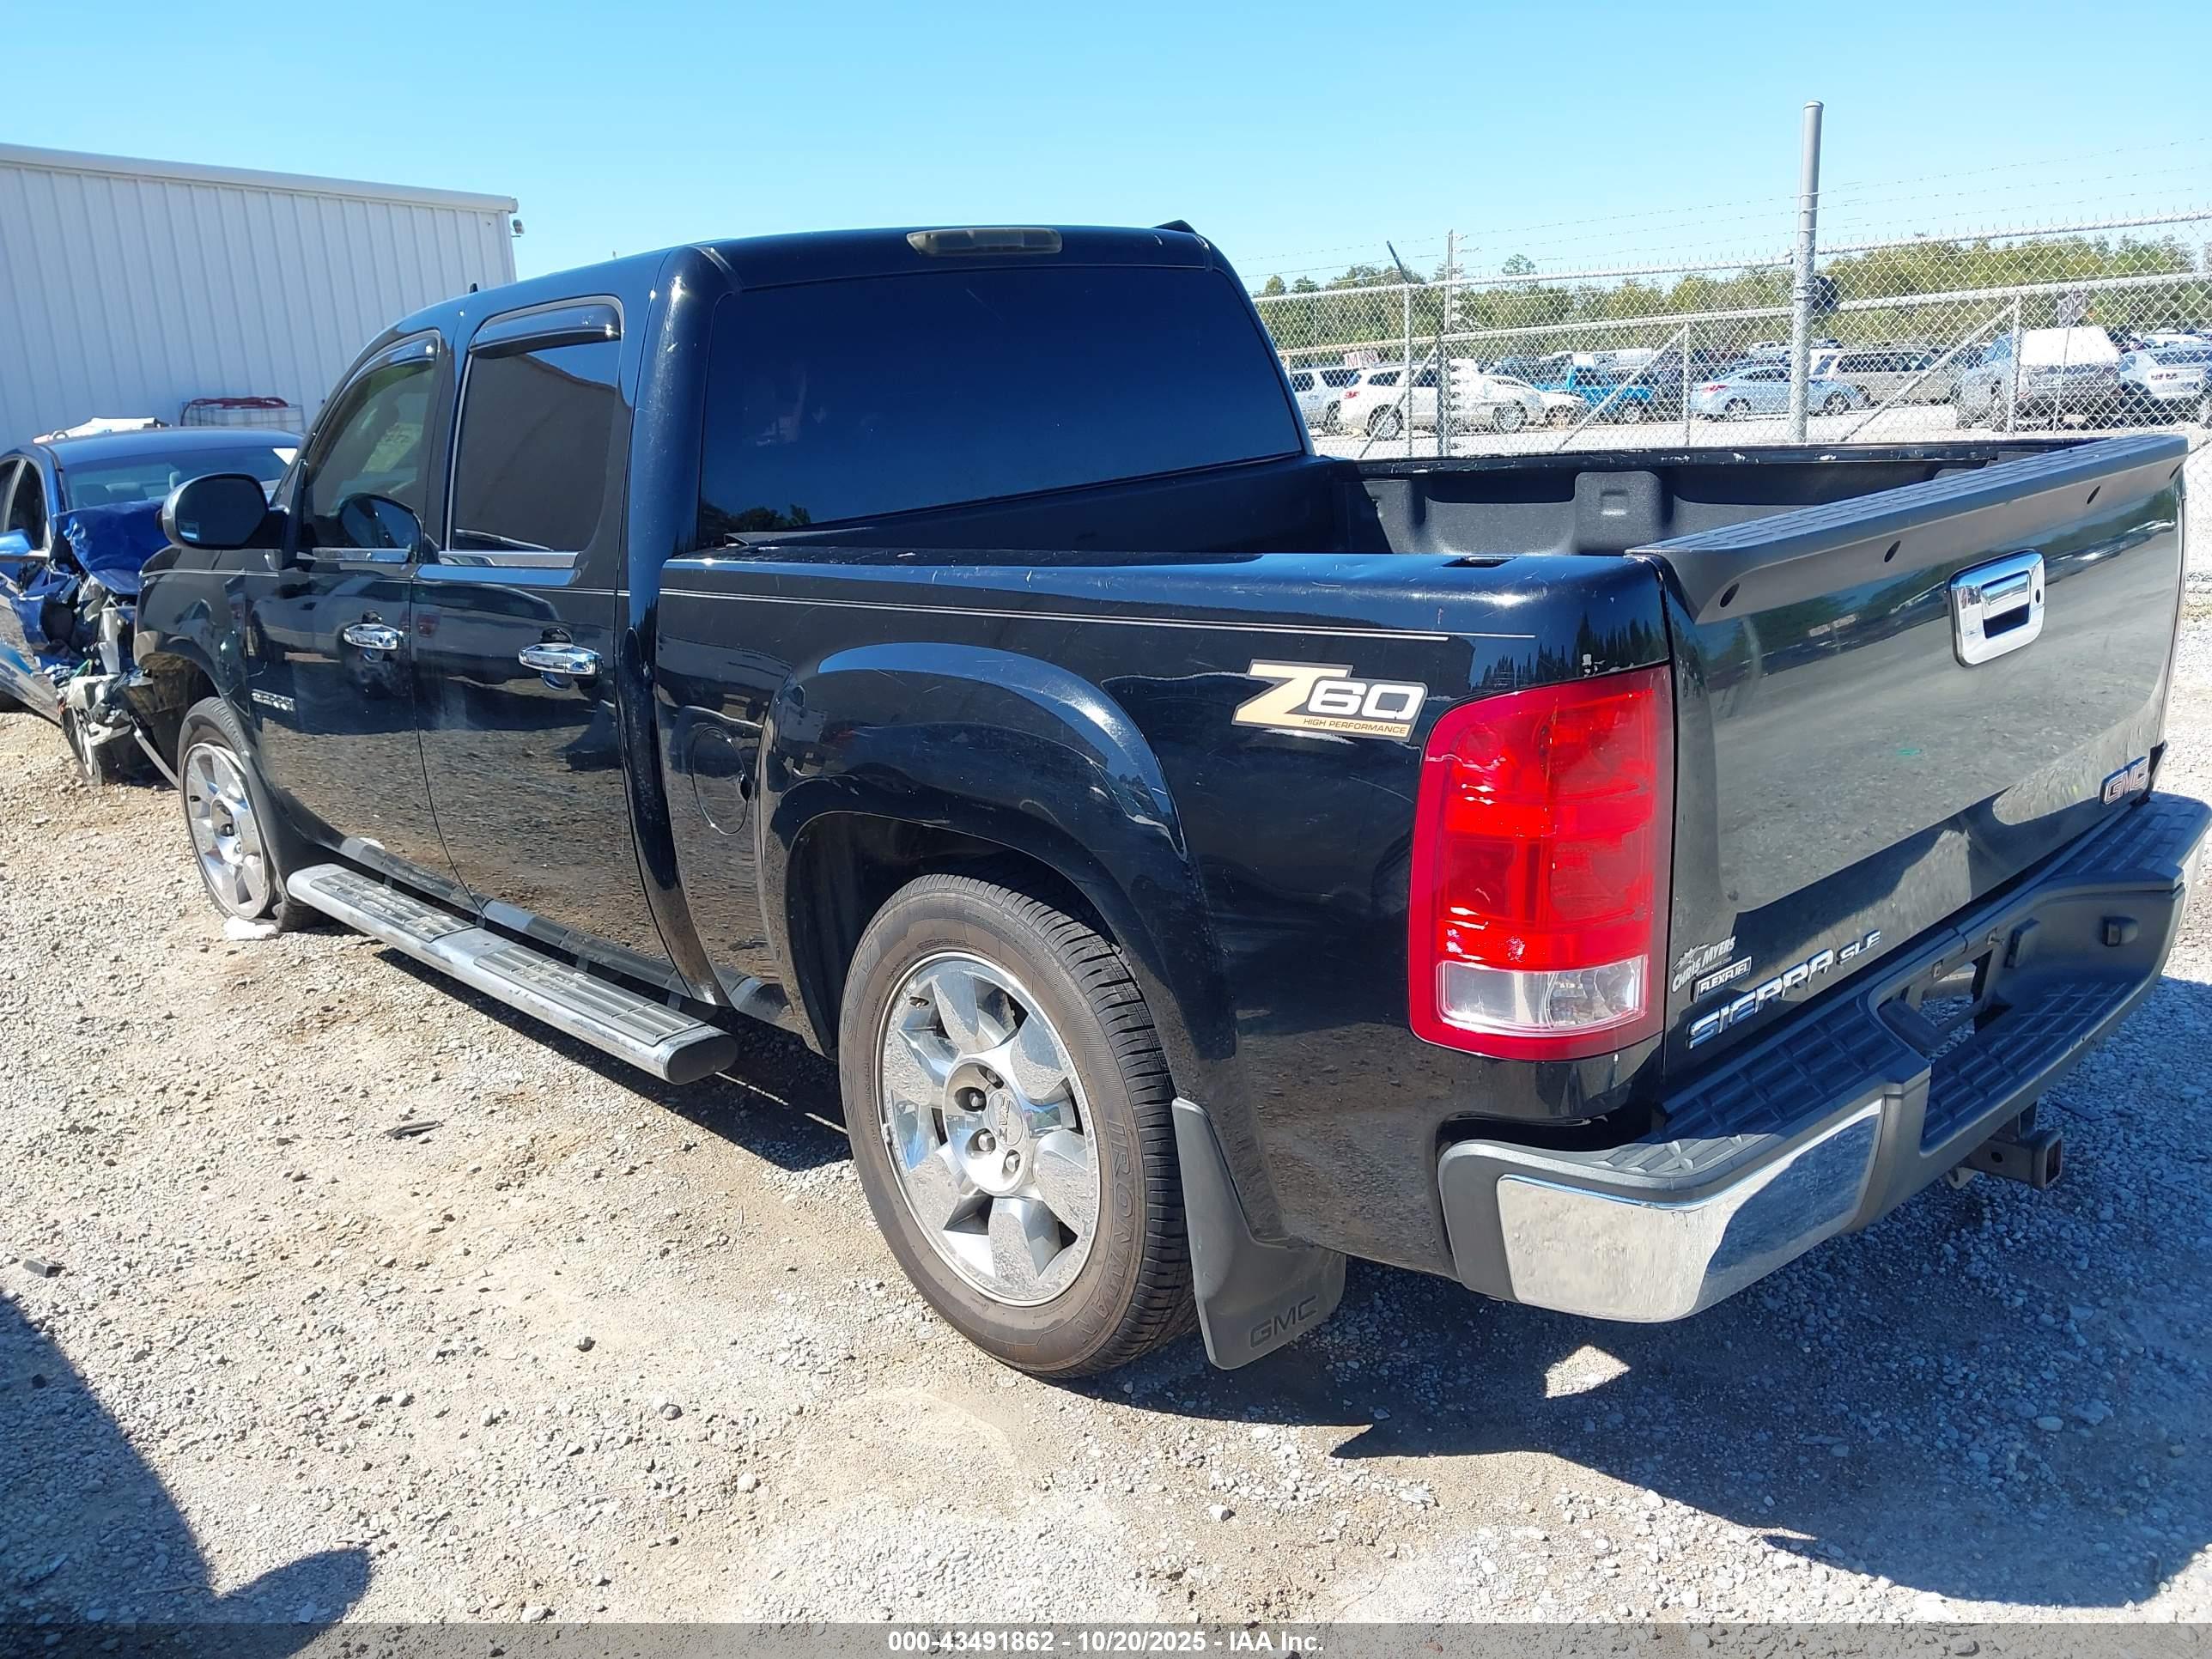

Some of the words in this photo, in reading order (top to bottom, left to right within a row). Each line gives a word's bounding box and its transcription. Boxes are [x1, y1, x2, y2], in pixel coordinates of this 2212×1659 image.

[1233, 660, 1427, 725] Z60
[1303, 717, 1327, 727] HIGH
[1328, 720, 1407, 735] PERFORMANCE
[2103, 756, 2149, 805] GMC
[1672, 957, 1702, 993] CHRIS
[1701, 935, 1736, 969] MYERS
[1687, 948, 1834, 1050] SIERRA
[1837, 928, 1881, 965] SLE
[1700, 962, 1749, 994] FLEXFUEL
[1072, 1118, 1133, 1344] IRONMAN
[1249, 1293, 1317, 1348] GMC
